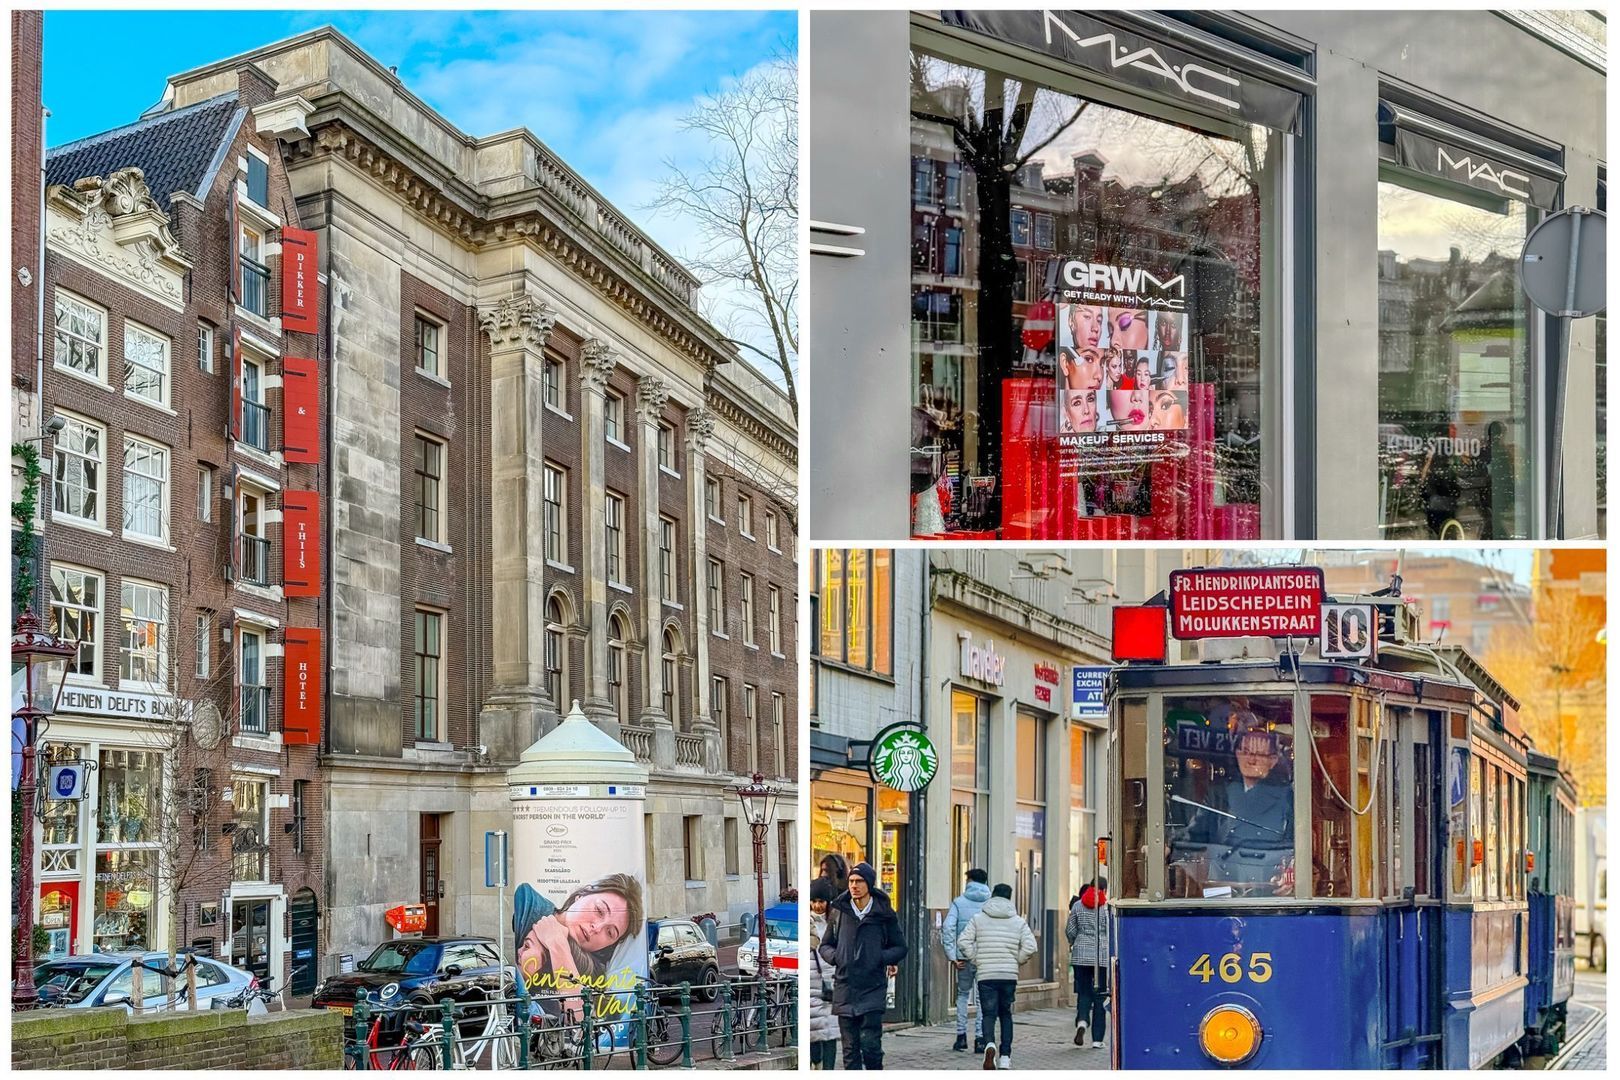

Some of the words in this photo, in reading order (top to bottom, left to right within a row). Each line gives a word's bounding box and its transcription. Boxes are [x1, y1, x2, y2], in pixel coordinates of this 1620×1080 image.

[1063, 290, 1082, 299] GET
[1083, 292, 1112, 301] READY
[1113, 294, 1135, 303] WITH
[297, 406, 306, 415] &
[1060, 435, 1108, 446] MAKEUP
[1113, 433, 1165, 443] SERVICES
[1427, 437, 1481, 457] STUDIO
[298, 523, 306, 568] THIJS
[1182, 594, 1312, 612] LEIDSCHEPLEIN
[1180, 614, 1316, 632] MOLUKKENSTRAAT
[1325, 608, 1368, 653] 10
[958, 630, 1006, 688] Travelex
[1076, 671, 1108, 680] CURREN
[299, 663, 307, 709] HOTEL
[61, 692, 102, 710] HEINEN
[108, 696, 147, 714] DELFTS
[1327, 882, 1334, 897] 3
[1188, 952, 1273, 984] 465
